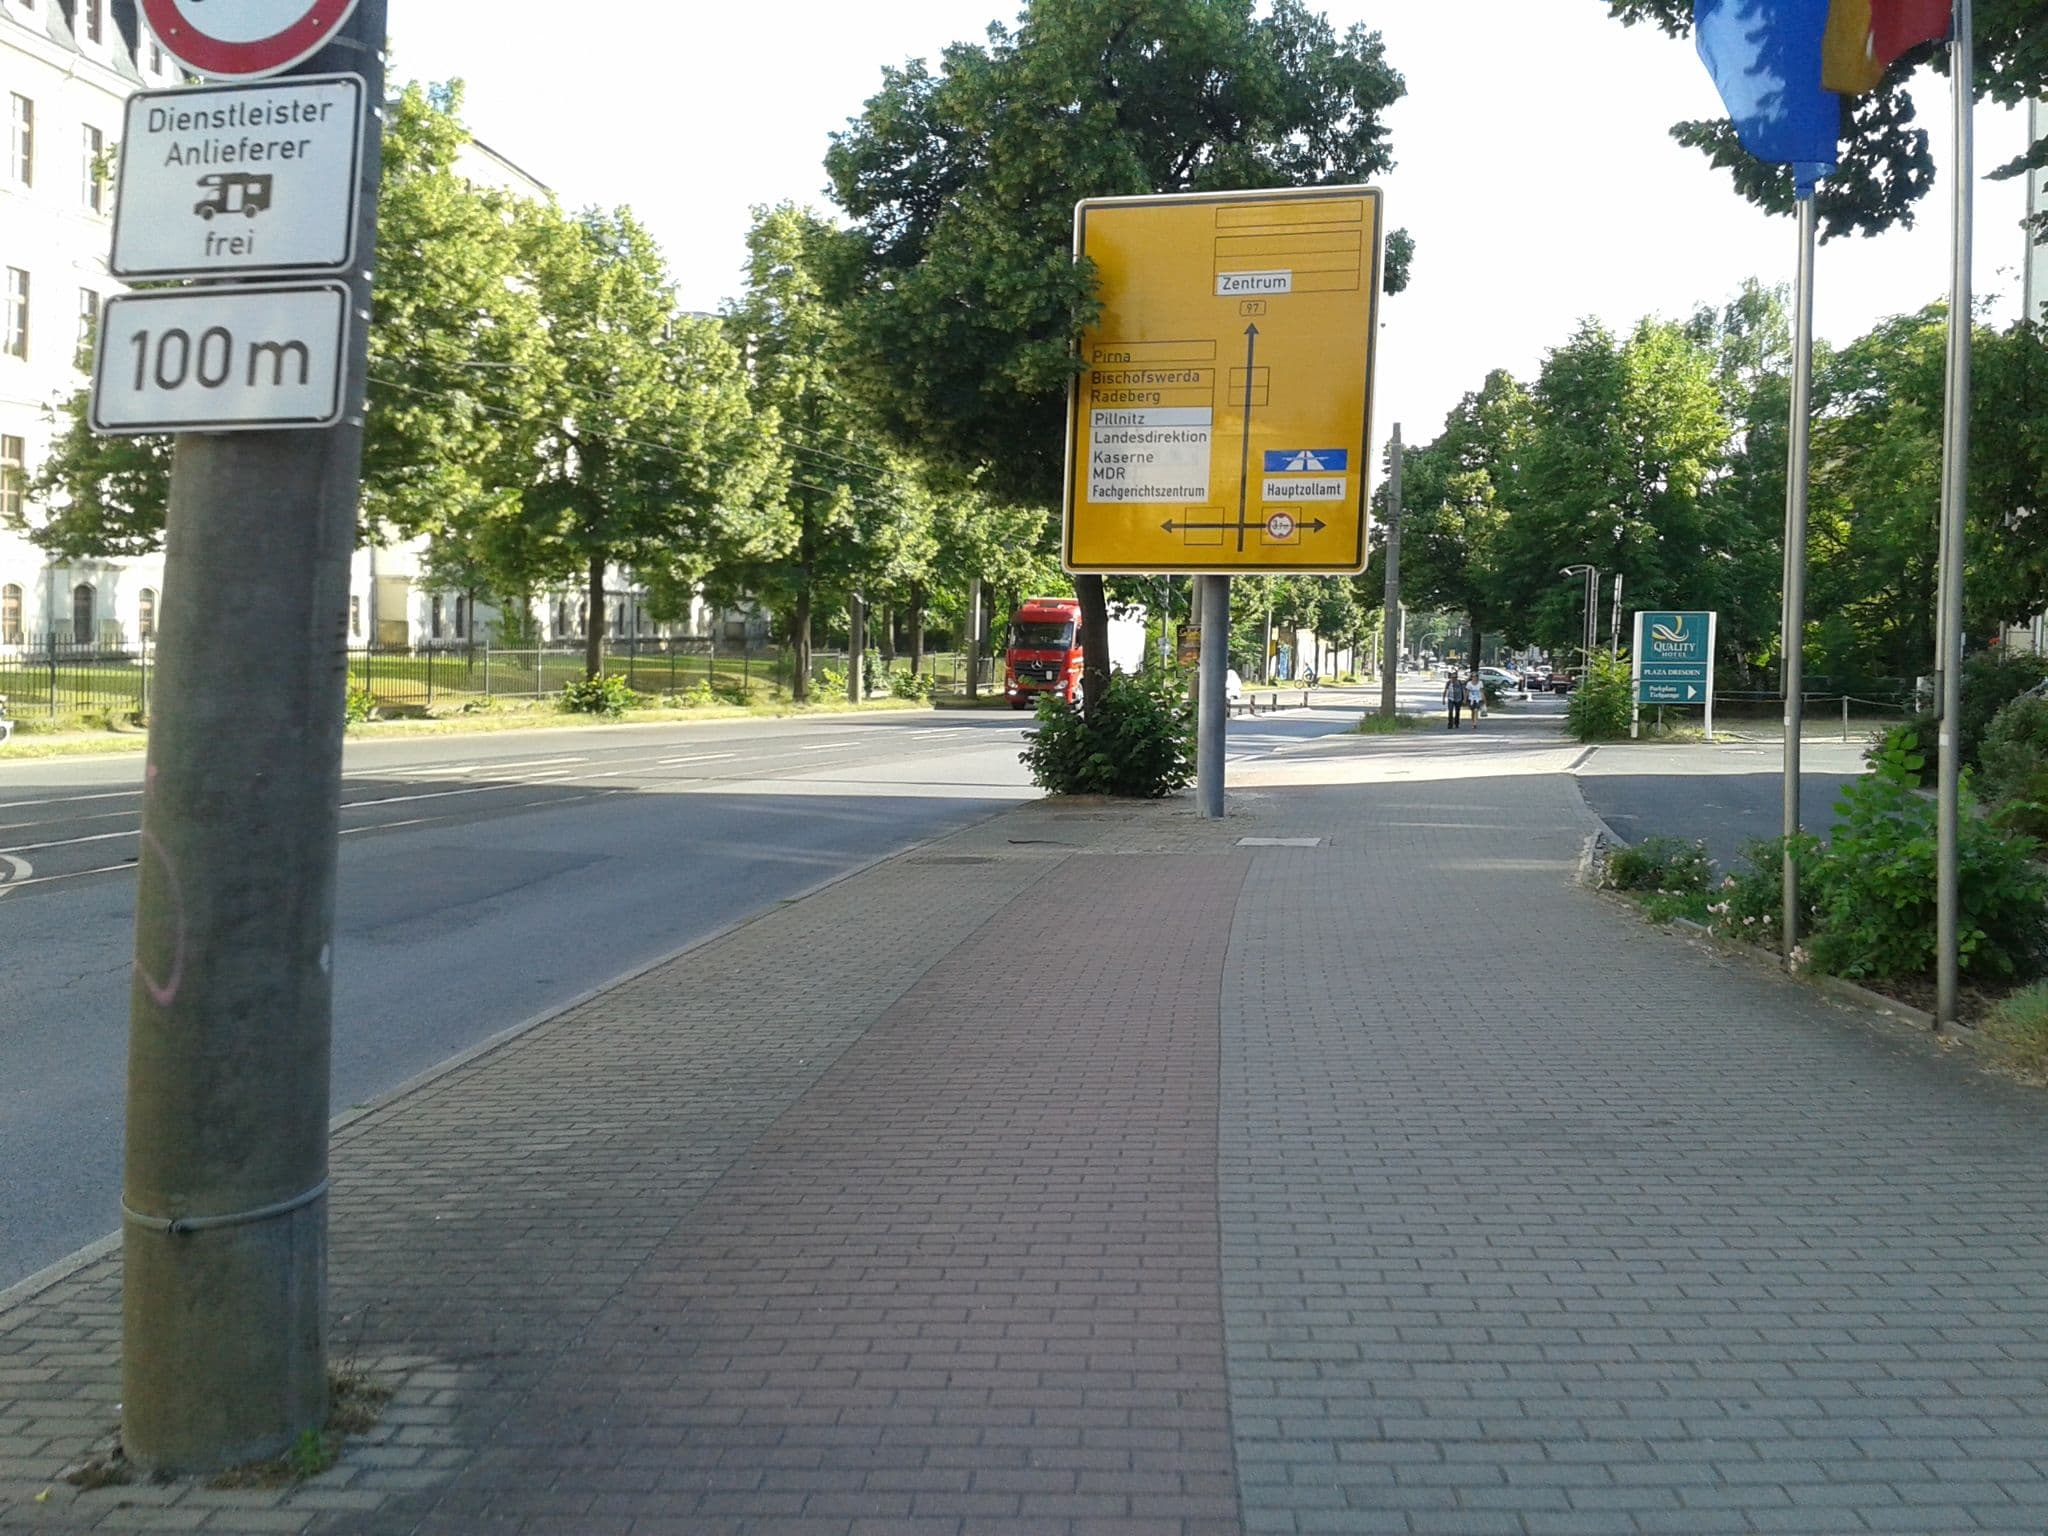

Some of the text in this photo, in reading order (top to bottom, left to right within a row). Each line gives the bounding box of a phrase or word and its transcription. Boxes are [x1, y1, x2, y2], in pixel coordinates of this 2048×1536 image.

[147, 100, 333, 133] Dienstleister
[164, 138, 311, 167] Anlieferer
[204, 230, 255, 257] frei
[1222, 275, 1287, 291] Zentrum
[1246, 303, 1260, 313] 97
[131, 326, 310, 391] 100 m
[1092, 350, 1131, 363] Pirna
[1091, 370, 1200, 384] Bischofswerda
[1091, 390, 1161, 404] Radeberg
[1094, 412, 1145, 425] Pillnitz
[1094, 430, 1207, 444] Landesdirektion
[1093, 451, 1154, 463] Kaserne
[1093, 467, 1126, 480] MDR
[1092, 485, 1205, 500] Fachgerichtszentrum
[1266, 482, 1342, 499] Hauptzollamt
[1653, 641, 1696, 653] QUALITY
